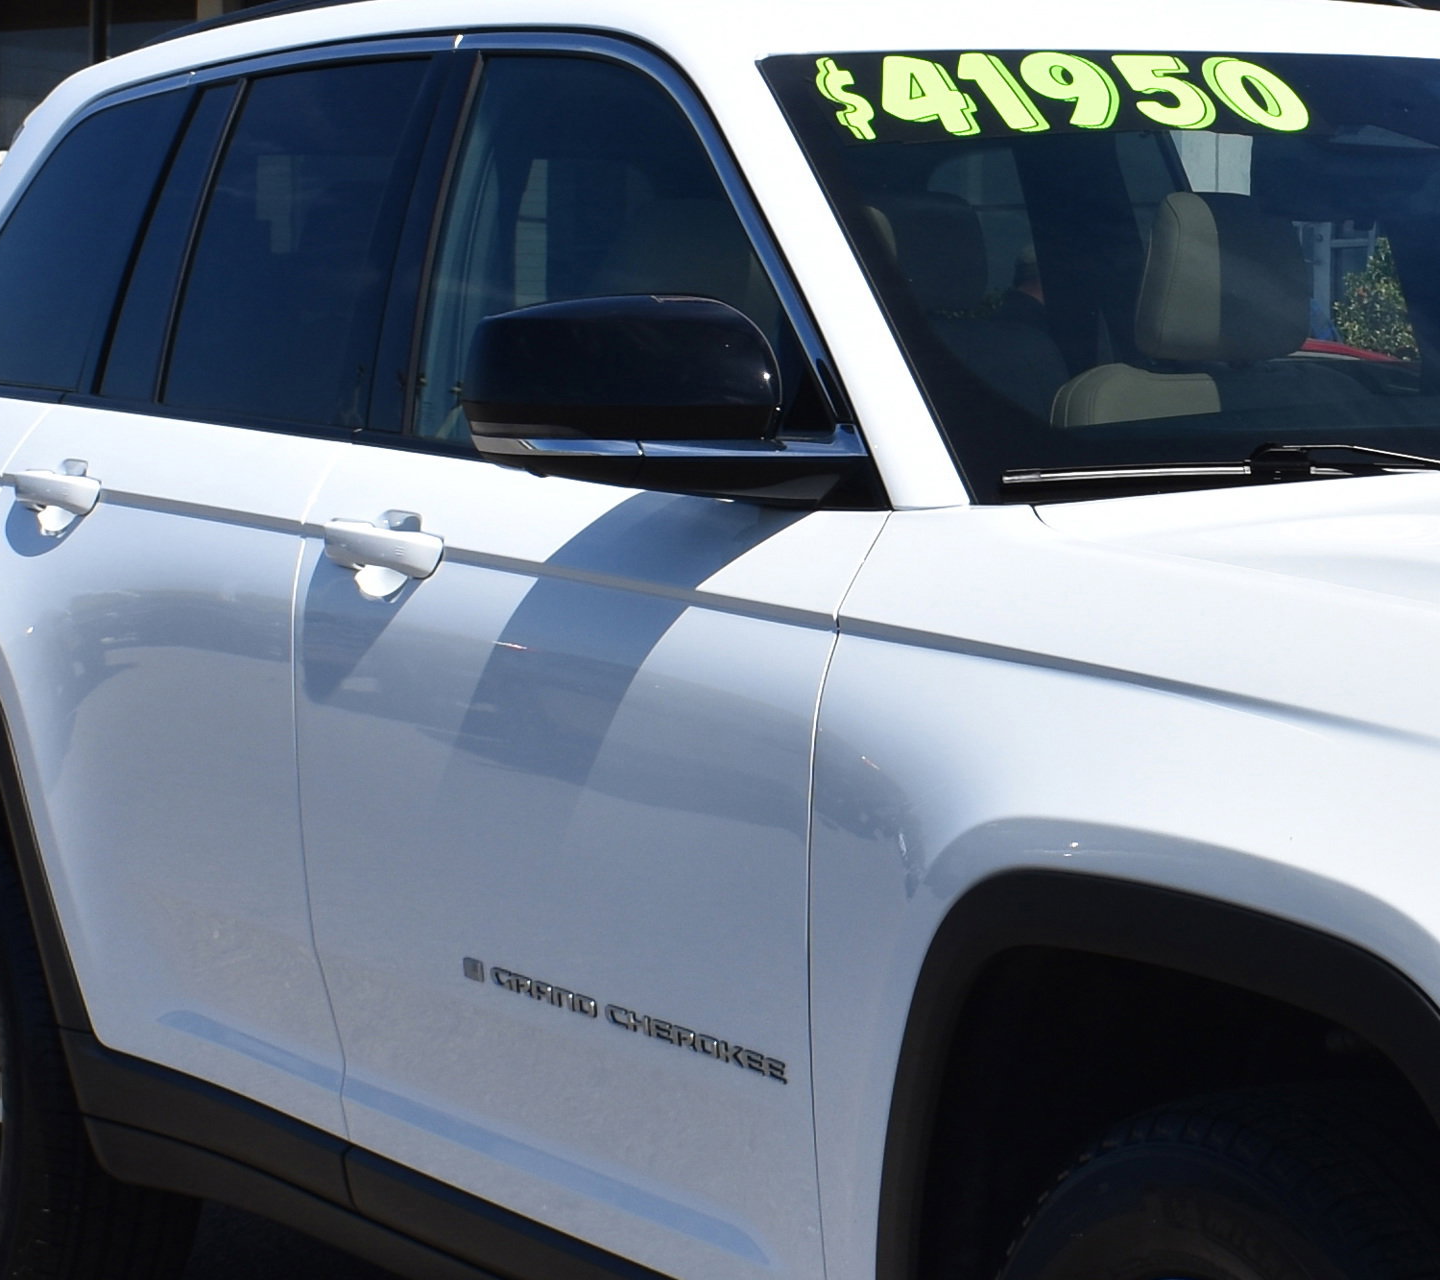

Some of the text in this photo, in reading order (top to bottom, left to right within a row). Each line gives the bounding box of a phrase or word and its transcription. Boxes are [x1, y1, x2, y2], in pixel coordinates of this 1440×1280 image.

[815, 50, 1310, 141] $41950
[490, 966, 788, 1085] GRAND CHEROKEE
